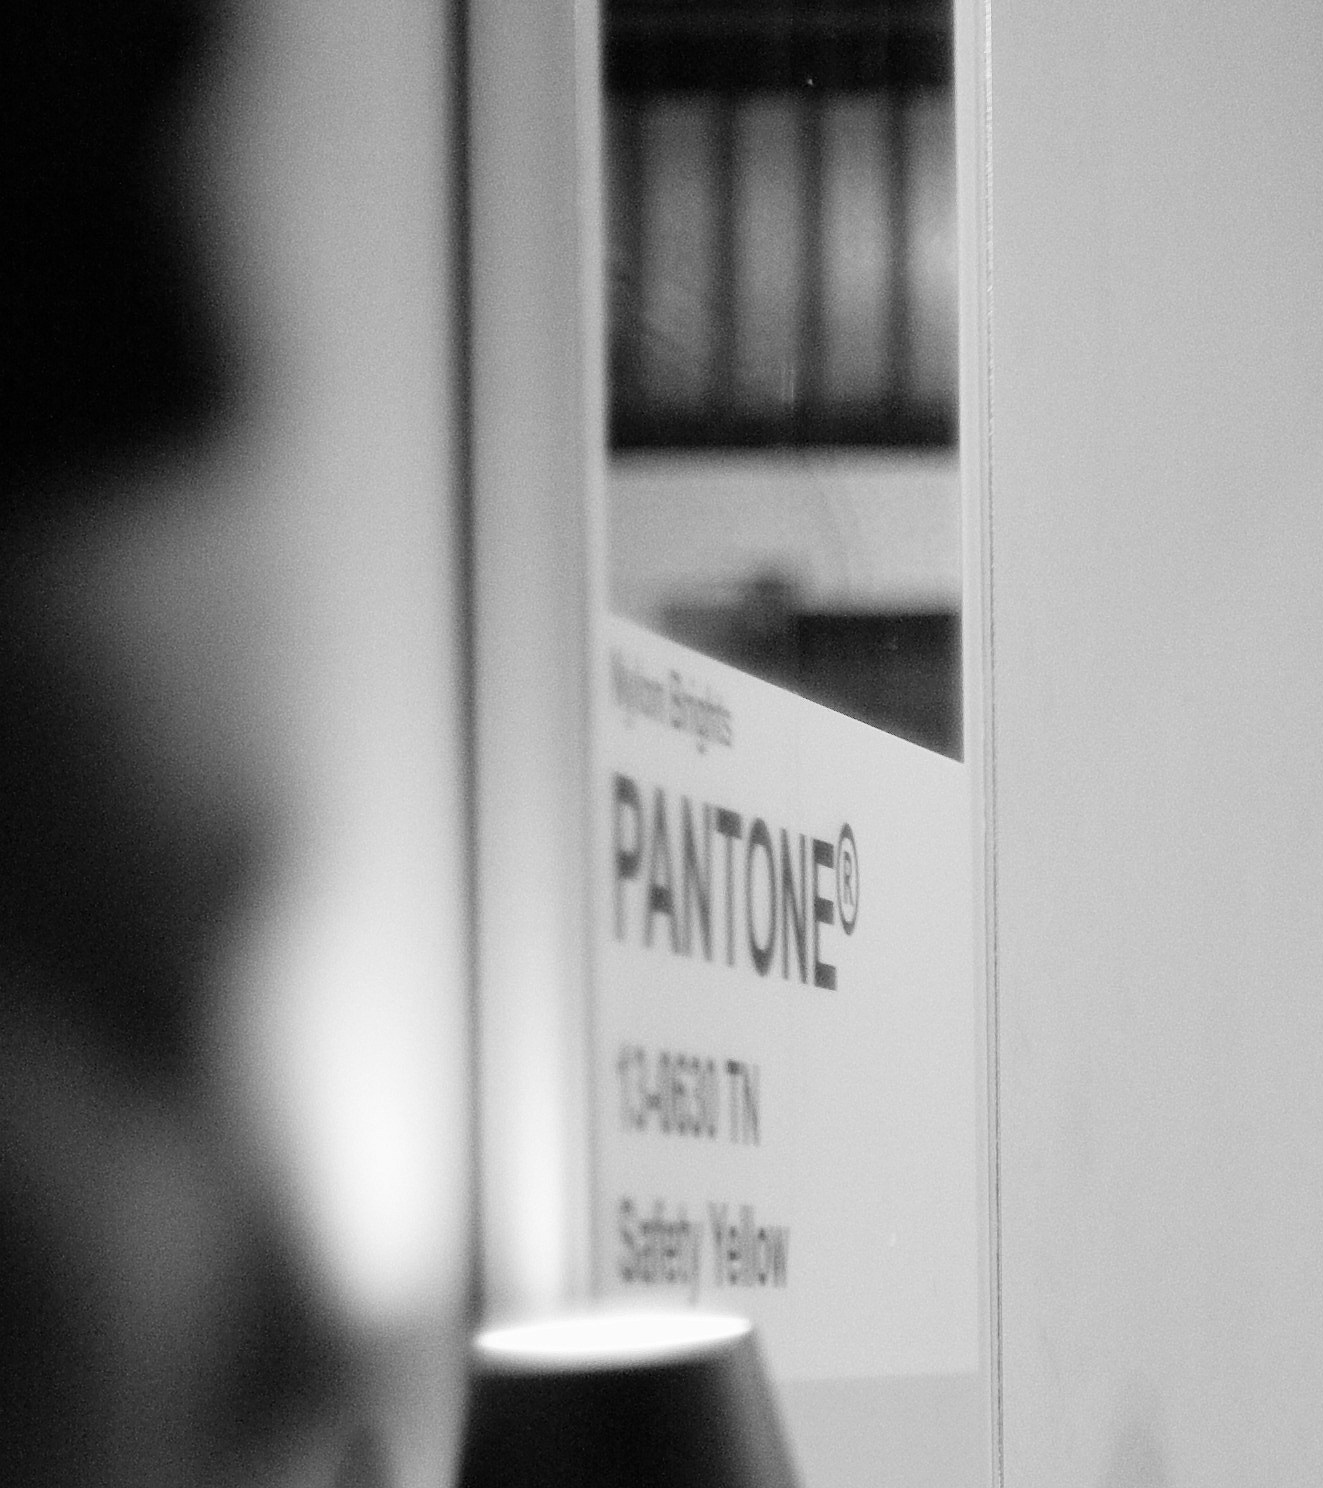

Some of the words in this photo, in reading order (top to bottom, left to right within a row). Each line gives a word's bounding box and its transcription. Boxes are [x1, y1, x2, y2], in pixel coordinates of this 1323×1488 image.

[726, 1056, 762, 1146] TN
[617, 1195, 701, 1304] Safety
[706, 1202, 792, 1289] Yellow
